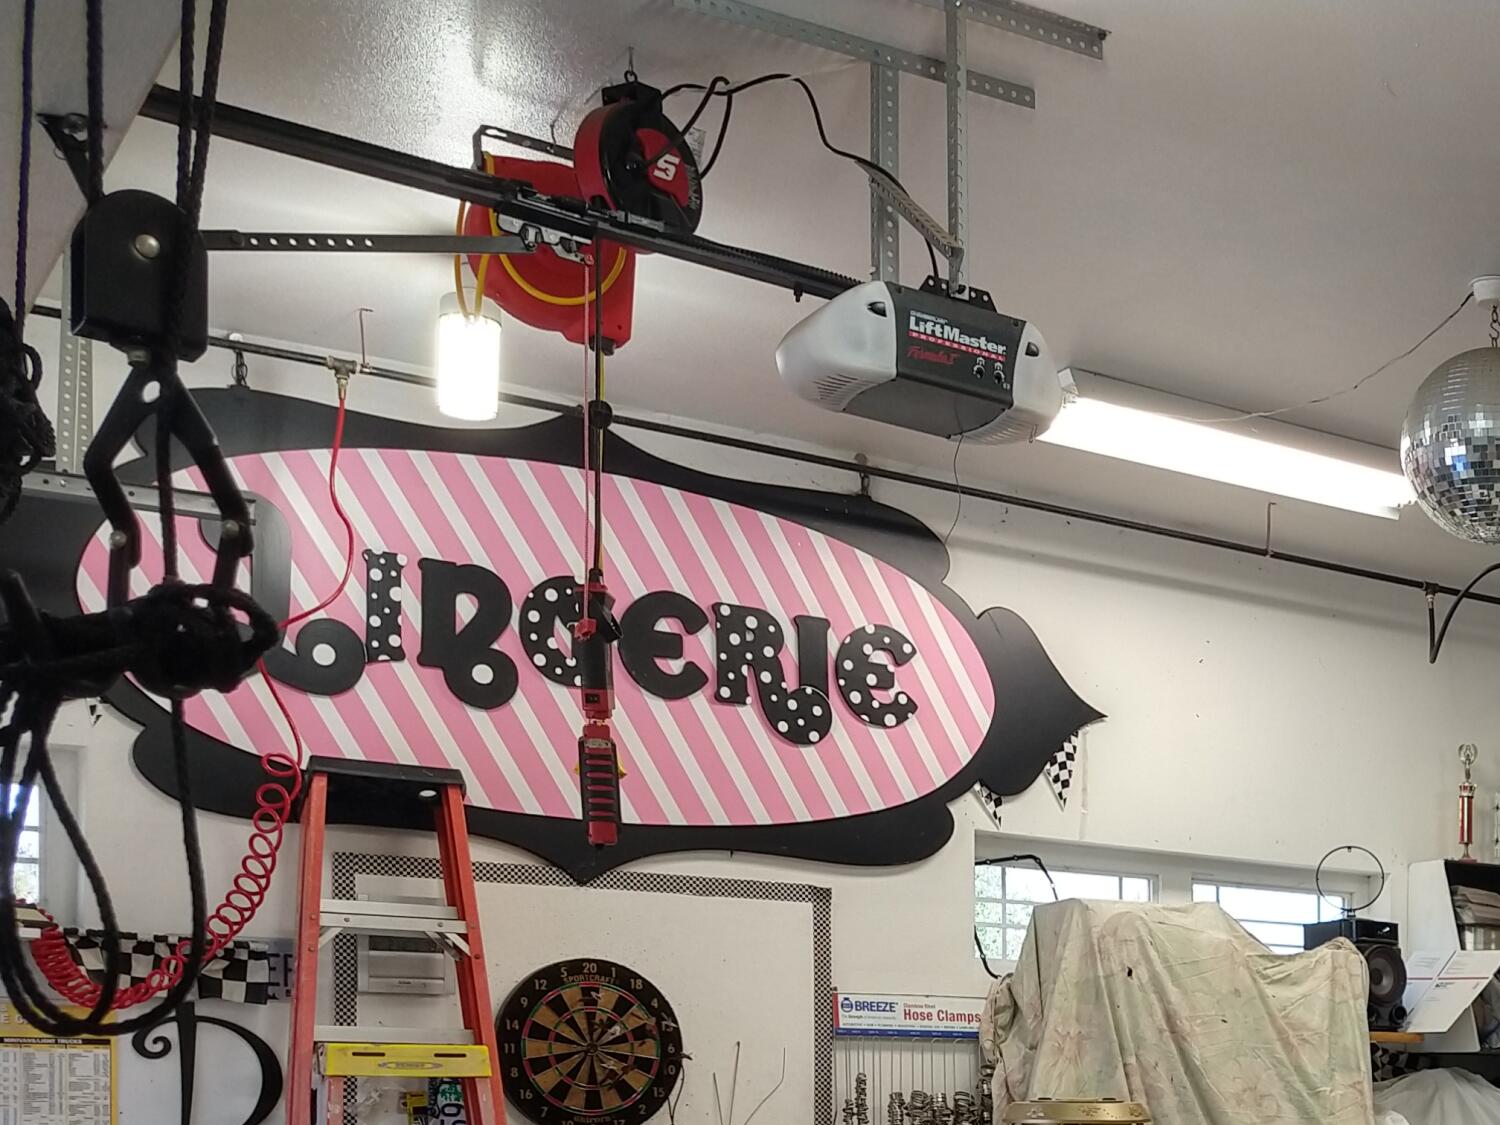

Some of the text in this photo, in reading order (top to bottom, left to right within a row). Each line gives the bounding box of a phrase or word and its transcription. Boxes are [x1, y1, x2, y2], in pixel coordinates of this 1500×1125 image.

[909, 315, 1007, 355] LiftMaster
[583, 963, 598, 974] 20
[534, 979, 548, 991] 12
[630, 978, 644, 990] 18
[521, 997, 529, 1008] 9
[651, 998, 659, 1009] 4
[855, 1000, 897, 1013] BREEZE
[903, 1008, 933, 1021] Hose
[937, 1009, 982, 1025] Clamps
[505, 1019, 520, 1030] 14
[504, 1043, 516, 1054] 11
[668, 1044, 675, 1054] 6
[511, 1067, 519, 1078] 8
[520, 1088, 534, 1100] 16
[653, 1086, 666, 1098] 15
[638, 1104, 646, 1115] 2
